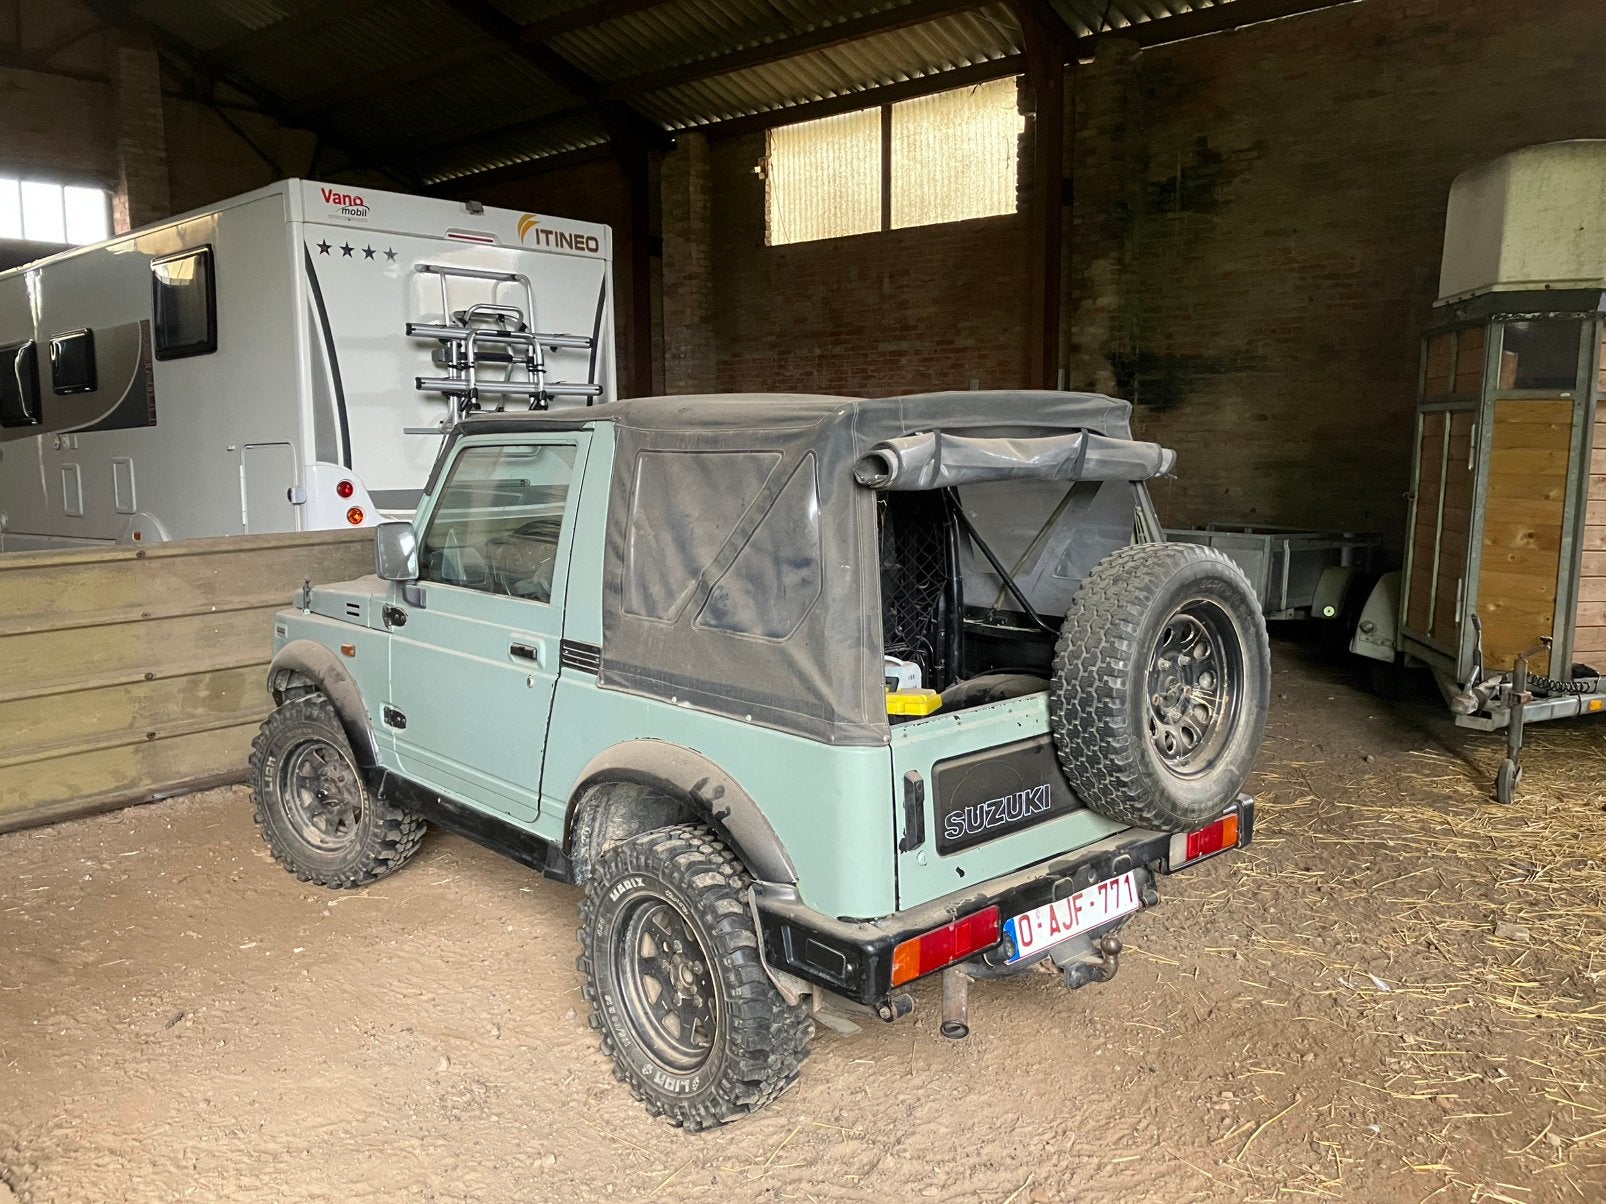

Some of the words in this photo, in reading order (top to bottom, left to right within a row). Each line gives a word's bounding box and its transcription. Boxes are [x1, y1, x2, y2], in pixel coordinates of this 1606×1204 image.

[321, 187, 364, 206] Vano
[341, 207, 367, 217] mobil
[535, 228, 599, 253] ITINEO
[944, 784, 1051, 840] SUZUKI
